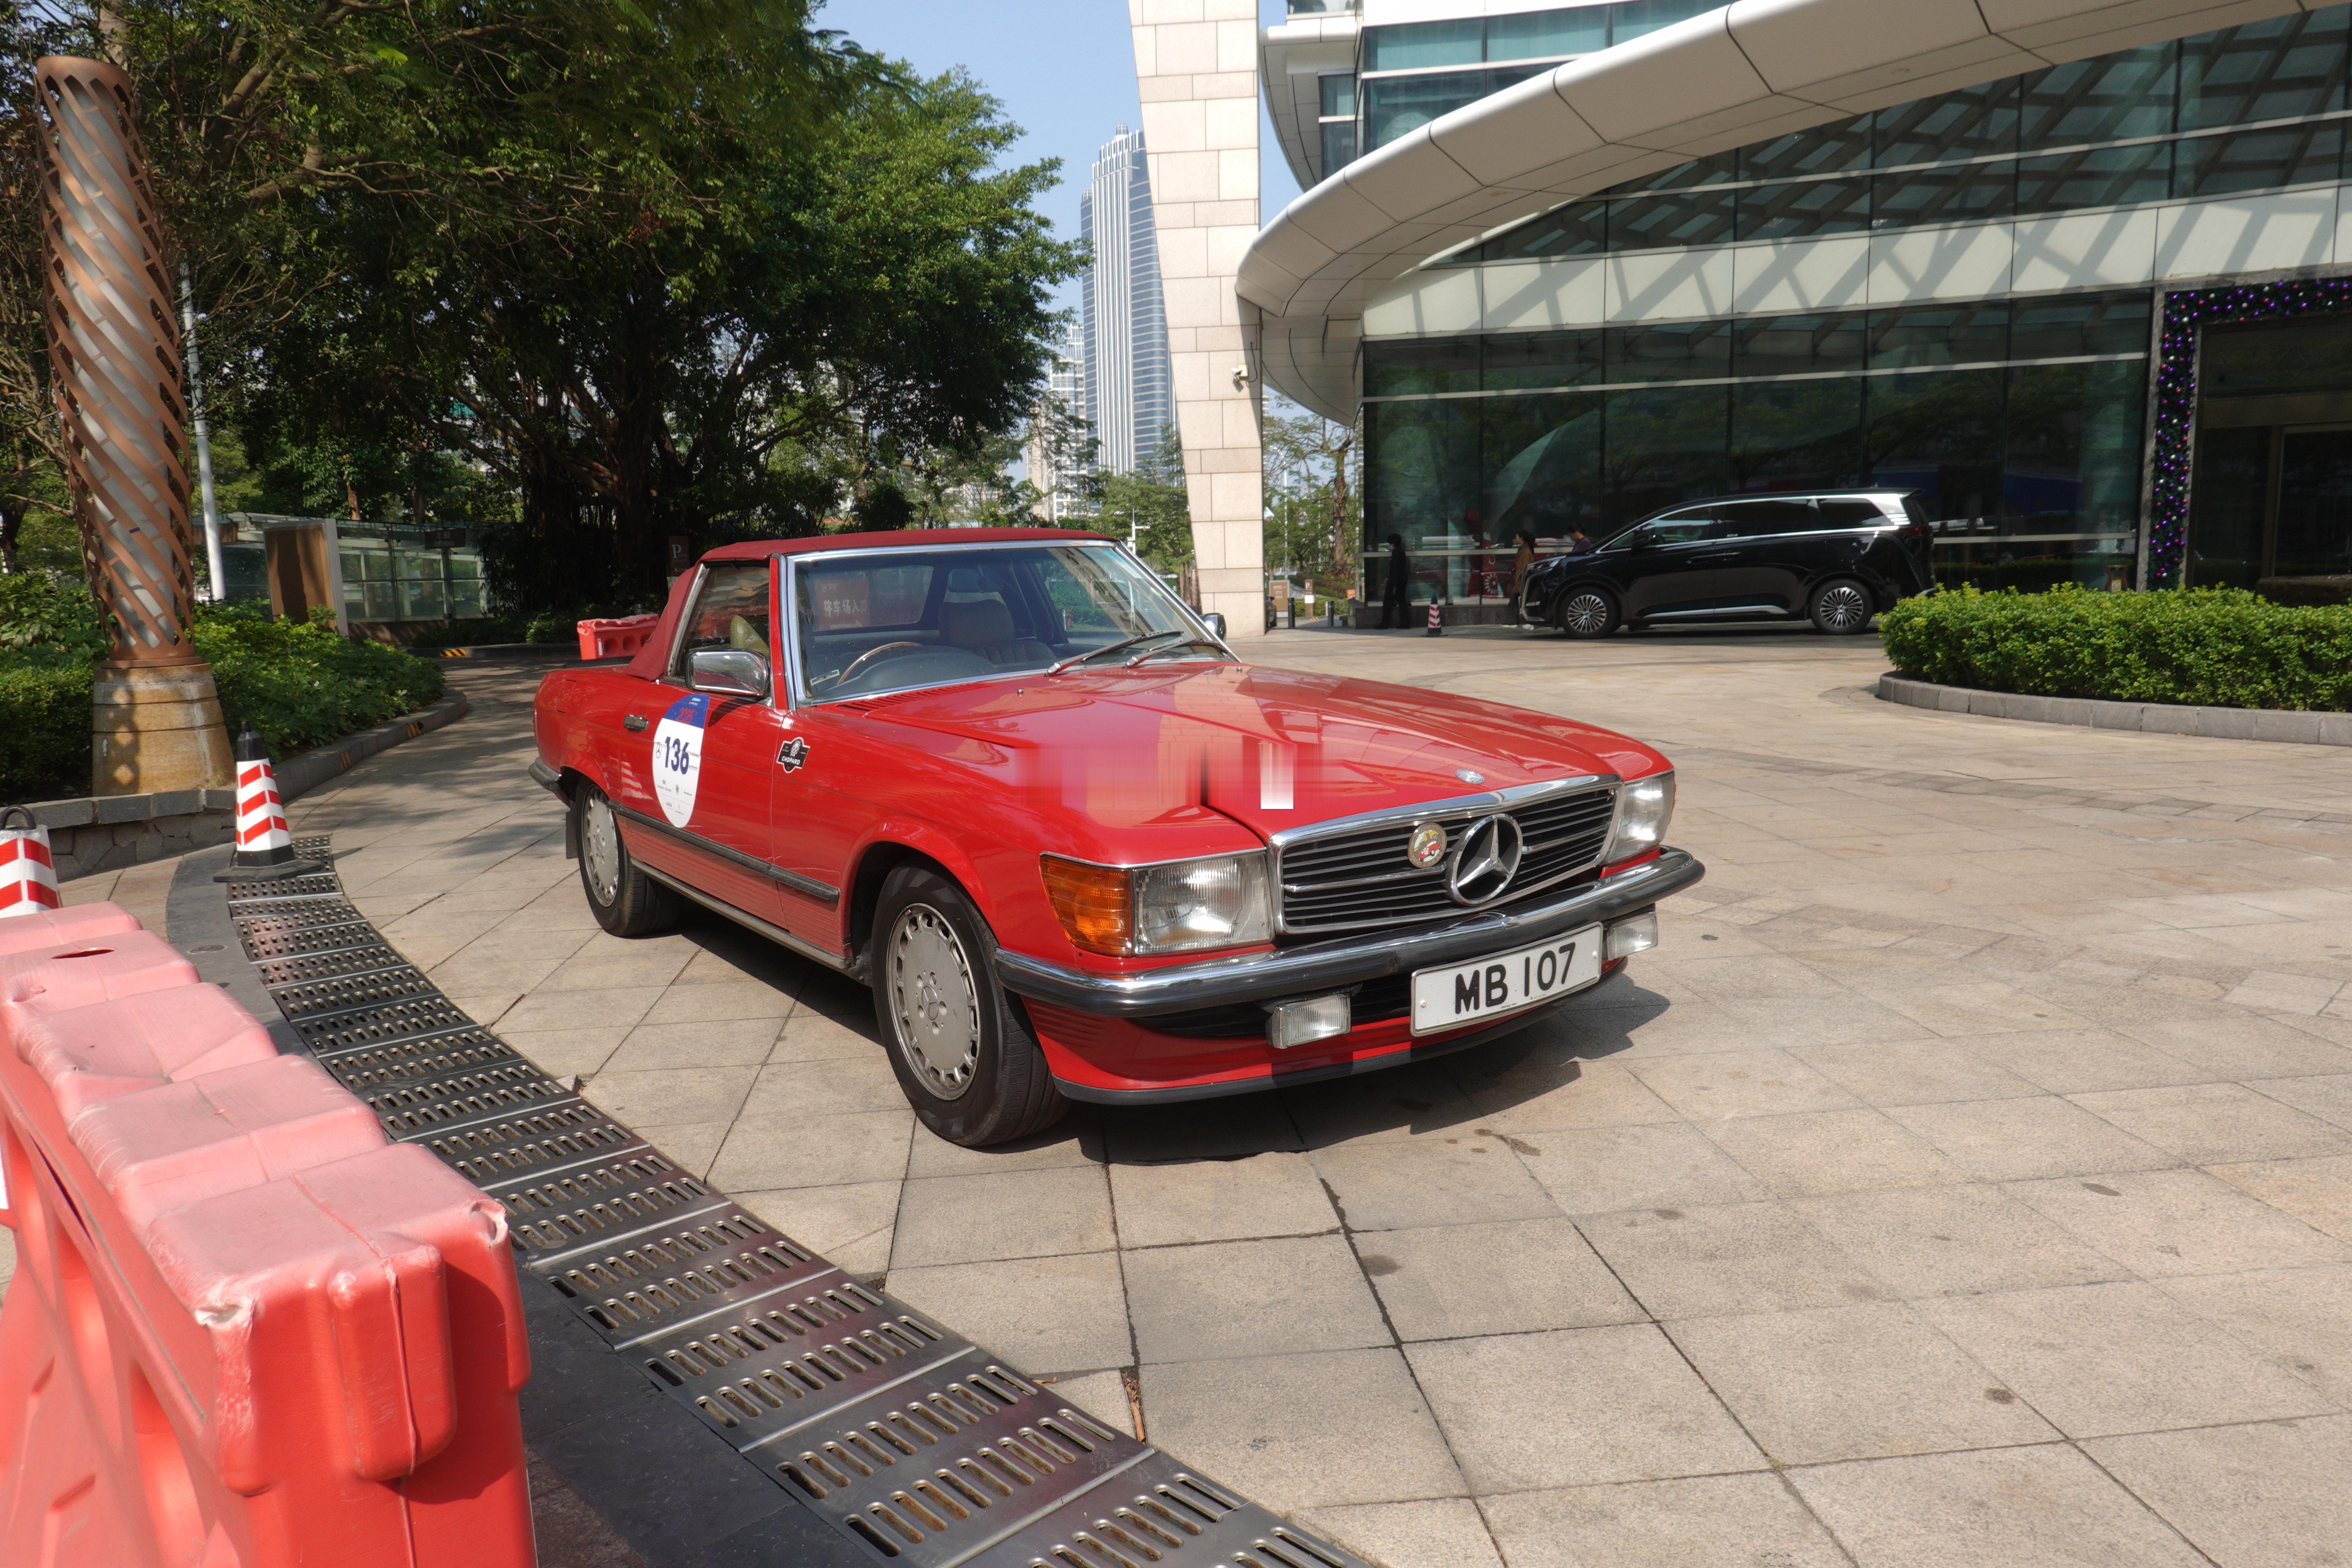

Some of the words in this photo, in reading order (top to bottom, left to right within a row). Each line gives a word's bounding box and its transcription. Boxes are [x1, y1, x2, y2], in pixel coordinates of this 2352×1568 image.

[665, 736, 690, 775] 136
[781, 756, 800, 765] CHOPARD
[1455, 964, 1508, 1014] MB
[1524, 942, 1576, 997] 107
